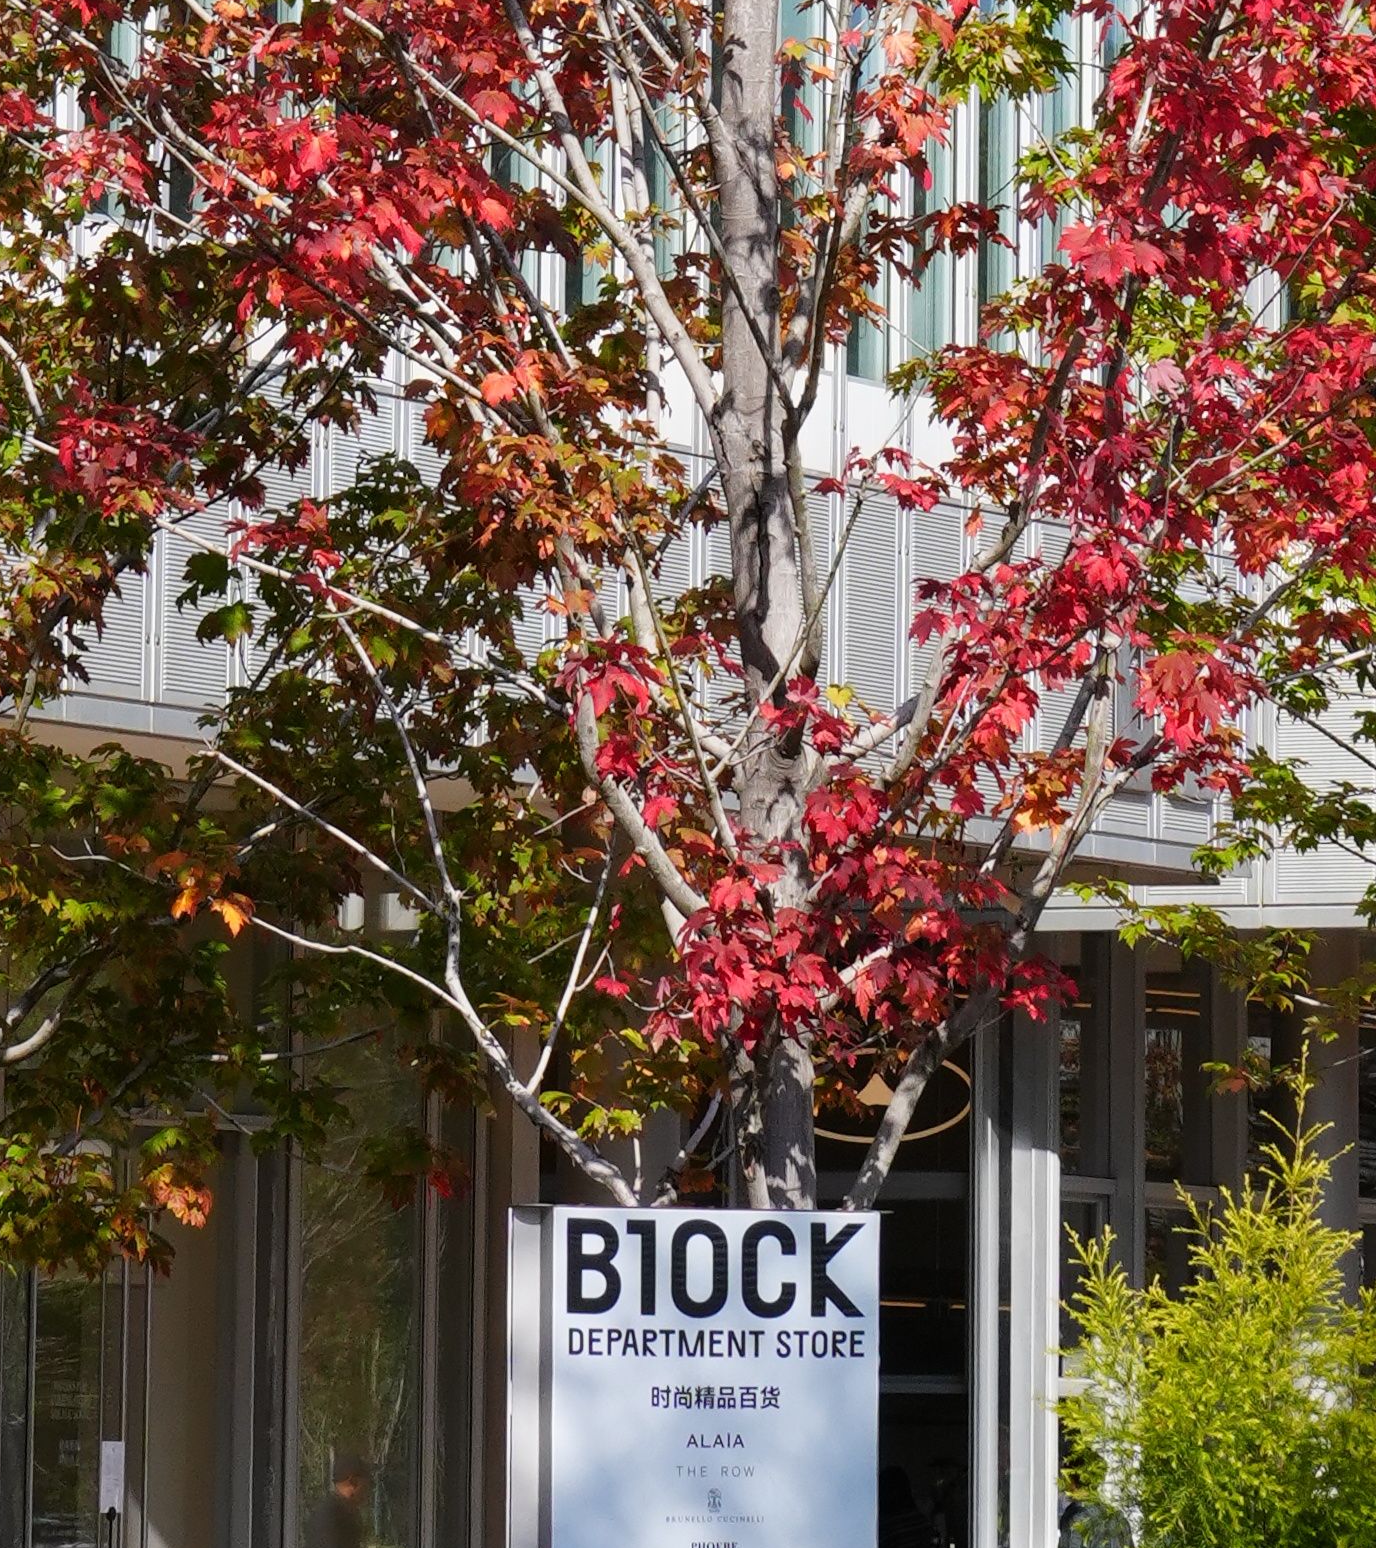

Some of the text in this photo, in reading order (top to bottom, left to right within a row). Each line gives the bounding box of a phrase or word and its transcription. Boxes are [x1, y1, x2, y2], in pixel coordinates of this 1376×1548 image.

[568, 1328, 865, 1359] DEPARTMENT STORE
[651, 1385, 781, 1410] 时尚精品百货
[676, 1465, 756, 1478] THE ROW
